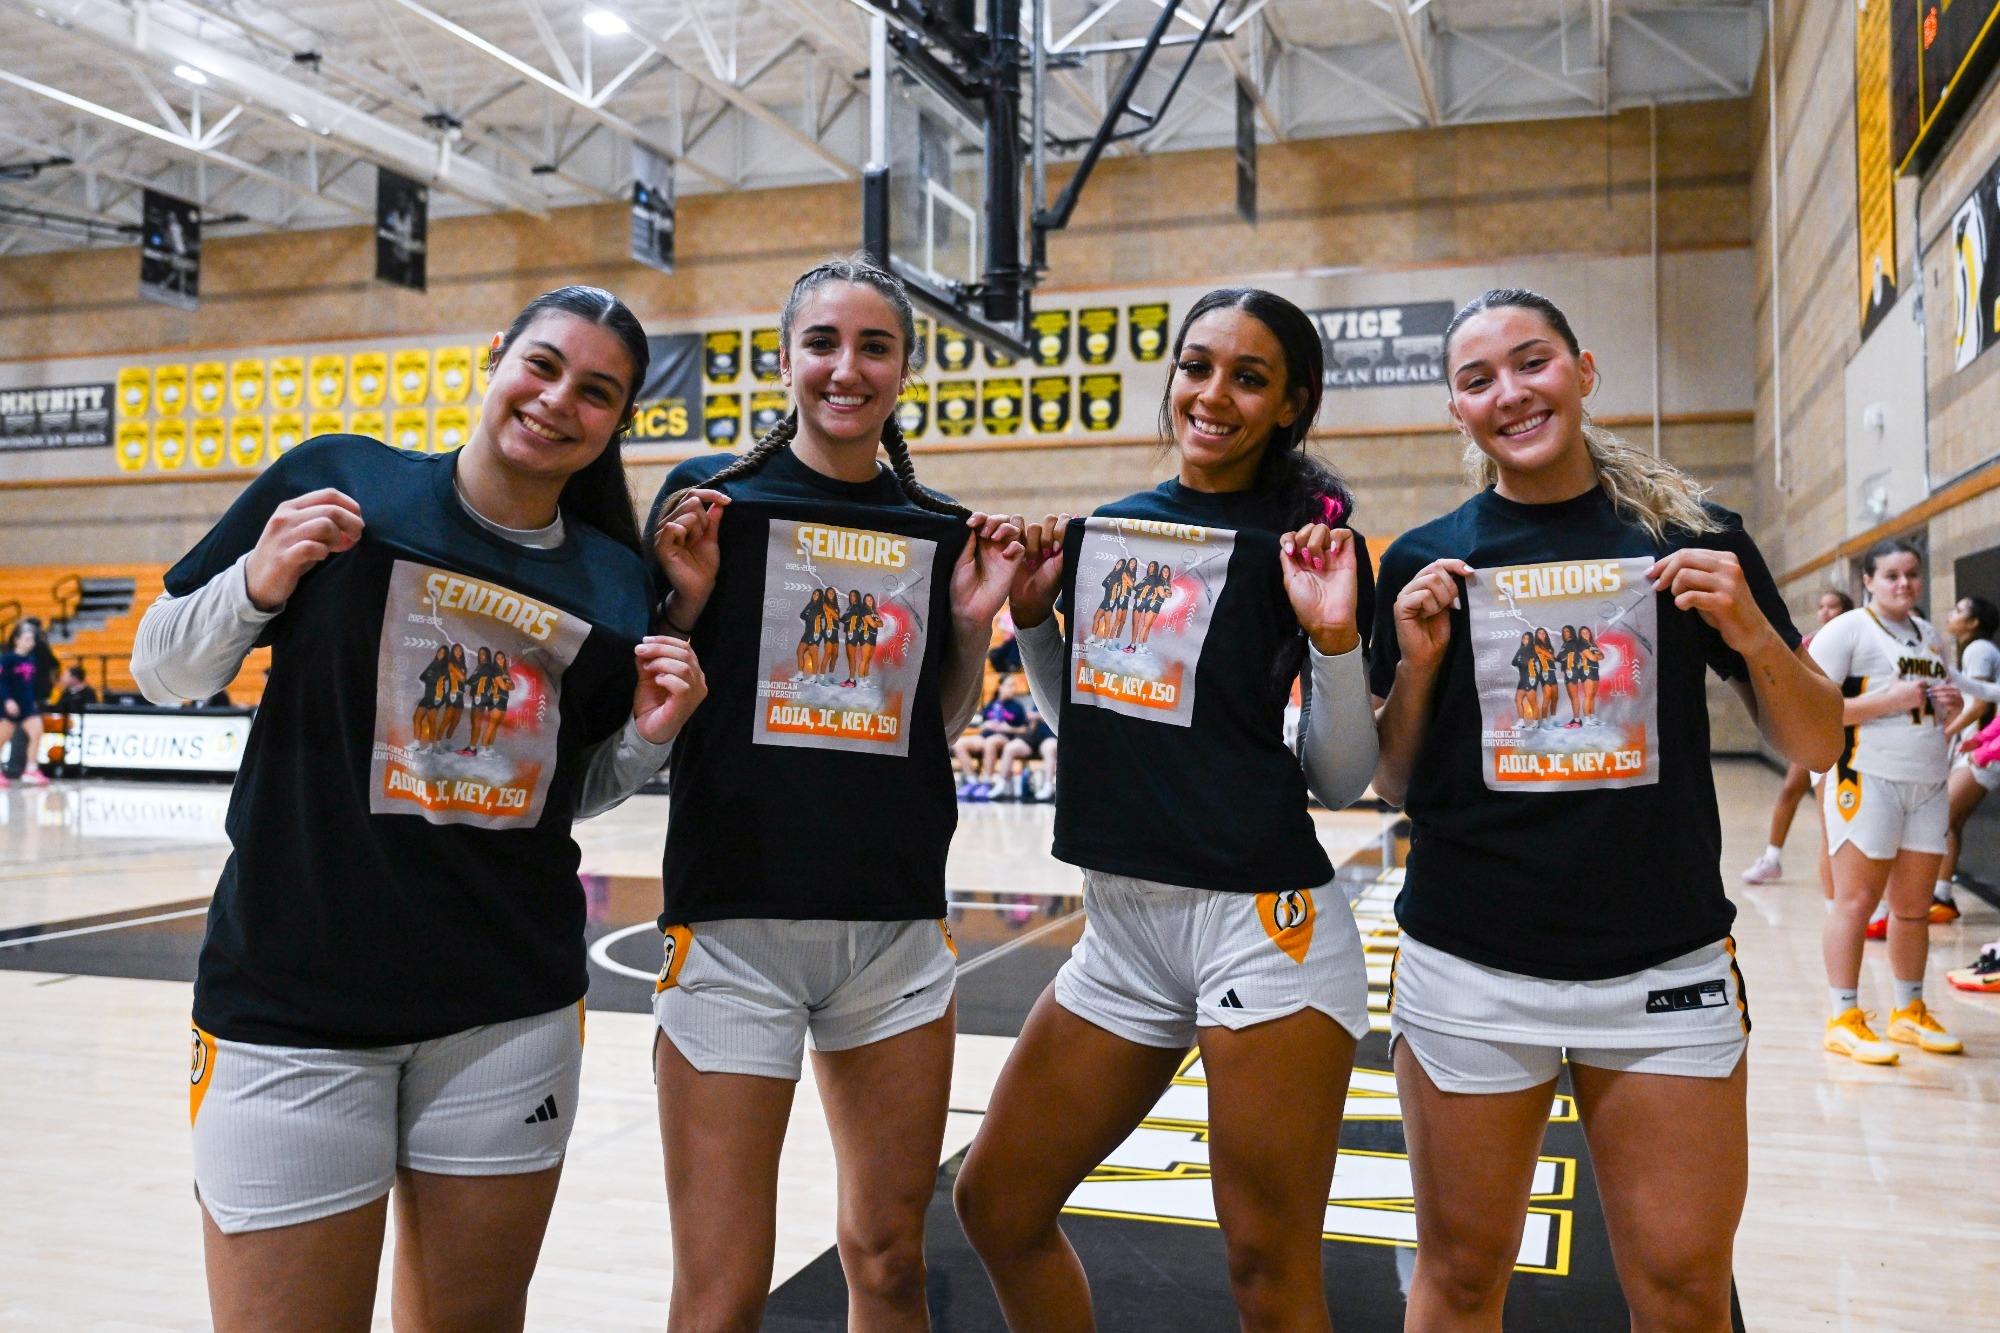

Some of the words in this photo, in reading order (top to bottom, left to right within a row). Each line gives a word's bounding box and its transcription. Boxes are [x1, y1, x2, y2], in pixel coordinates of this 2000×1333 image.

[1375, 363, 1441, 383] IDEALS
[0, 386, 105, 415] MMUNITY
[796, 526, 907, 568] SENIORS
[1495, 562, 1621, 600] SENIORS
[422, 572, 558, 641] SENIORS
[765, 597, 791, 620] 22
[758, 680, 799, 690] DOMINICAN
[758, 689, 802, 700] UNIVERSITY
[1099, 671, 1119, 696] JC,
[1122, 676, 1147, 702] KEY,
[1149, 681, 1175, 703] ISO
[769, 705, 815, 730] ADIA,
[817, 709, 838, 732] JC,
[841, 712, 874, 735] KEY,
[877, 715, 898, 735] ISO
[1483, 730, 1521, 739] DOMINICAN
[1483, 738, 1526, 748] UNIVERSITY
[1499, 754, 1545, 777] ADIA,
[1547, 754, 1570, 777] JC,
[1573, 753, 1611, 774] KEY,
[1614, 750, 1642, 771] ISO
[388, 769, 432, 805] ADIA,
[453, 781, 493, 810] KEY,
[496, 788, 527, 808] ISO
